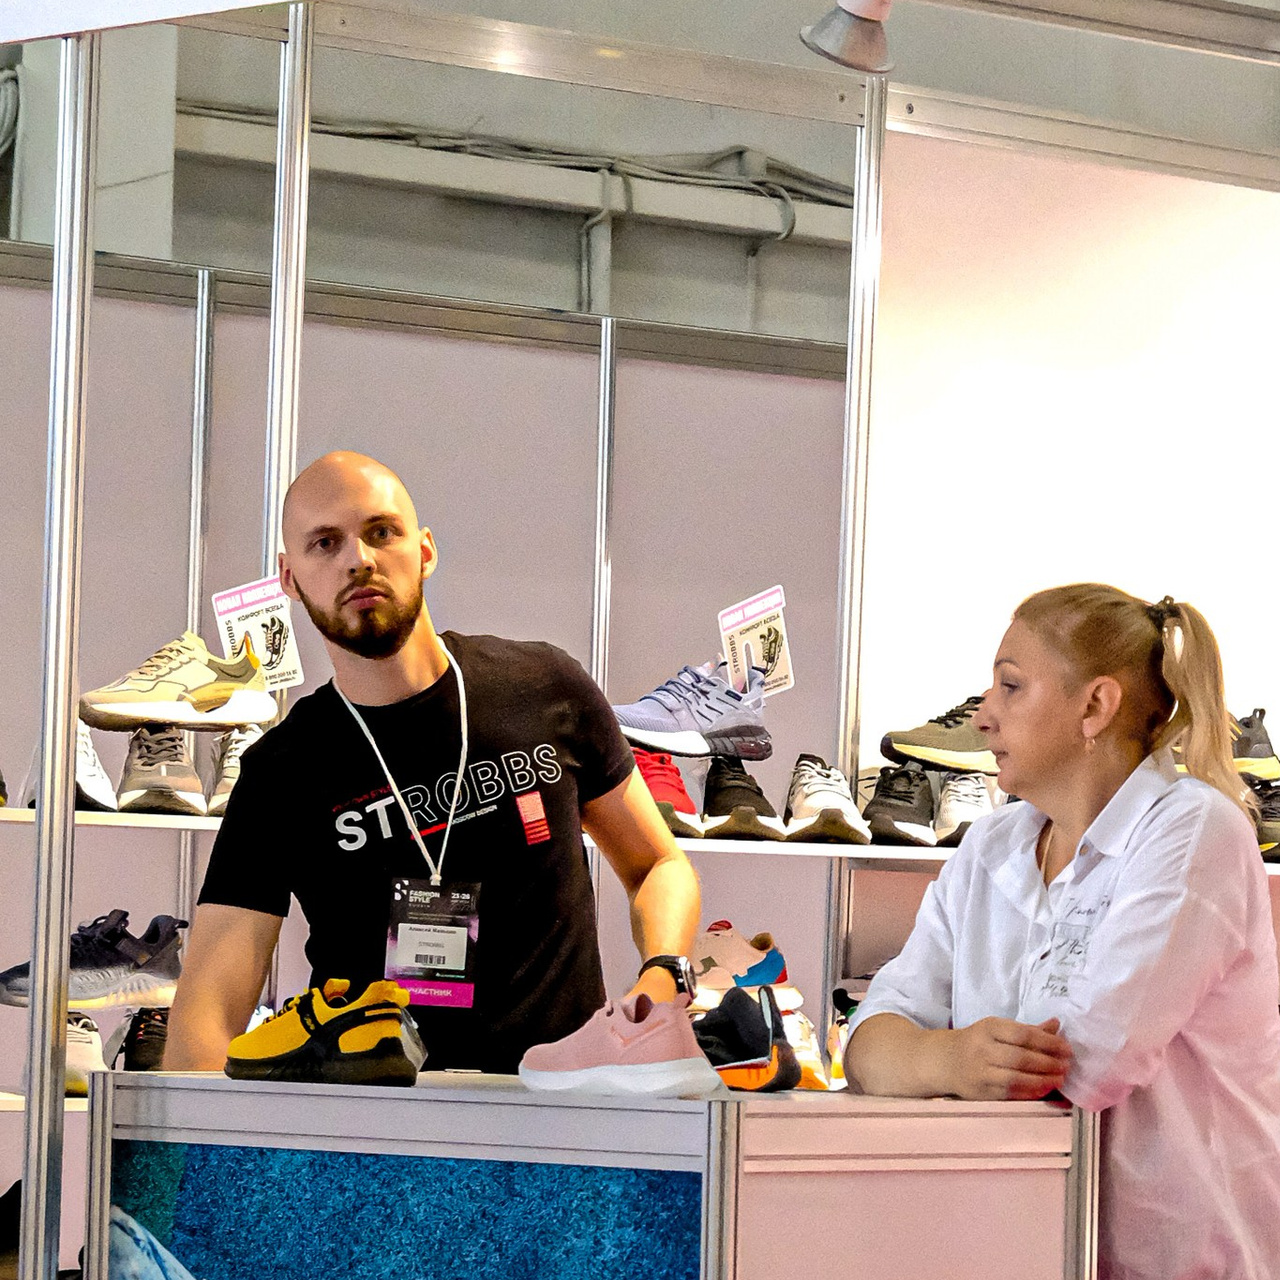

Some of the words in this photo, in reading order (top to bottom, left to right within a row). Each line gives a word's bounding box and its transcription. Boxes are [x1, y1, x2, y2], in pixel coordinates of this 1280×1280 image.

[224, 619, 239, 658] TROBBS
[728, 634, 741, 674] STROBBS
[335, 744, 562, 851] STROBBS
[409, 890, 440, 898] FASHION
